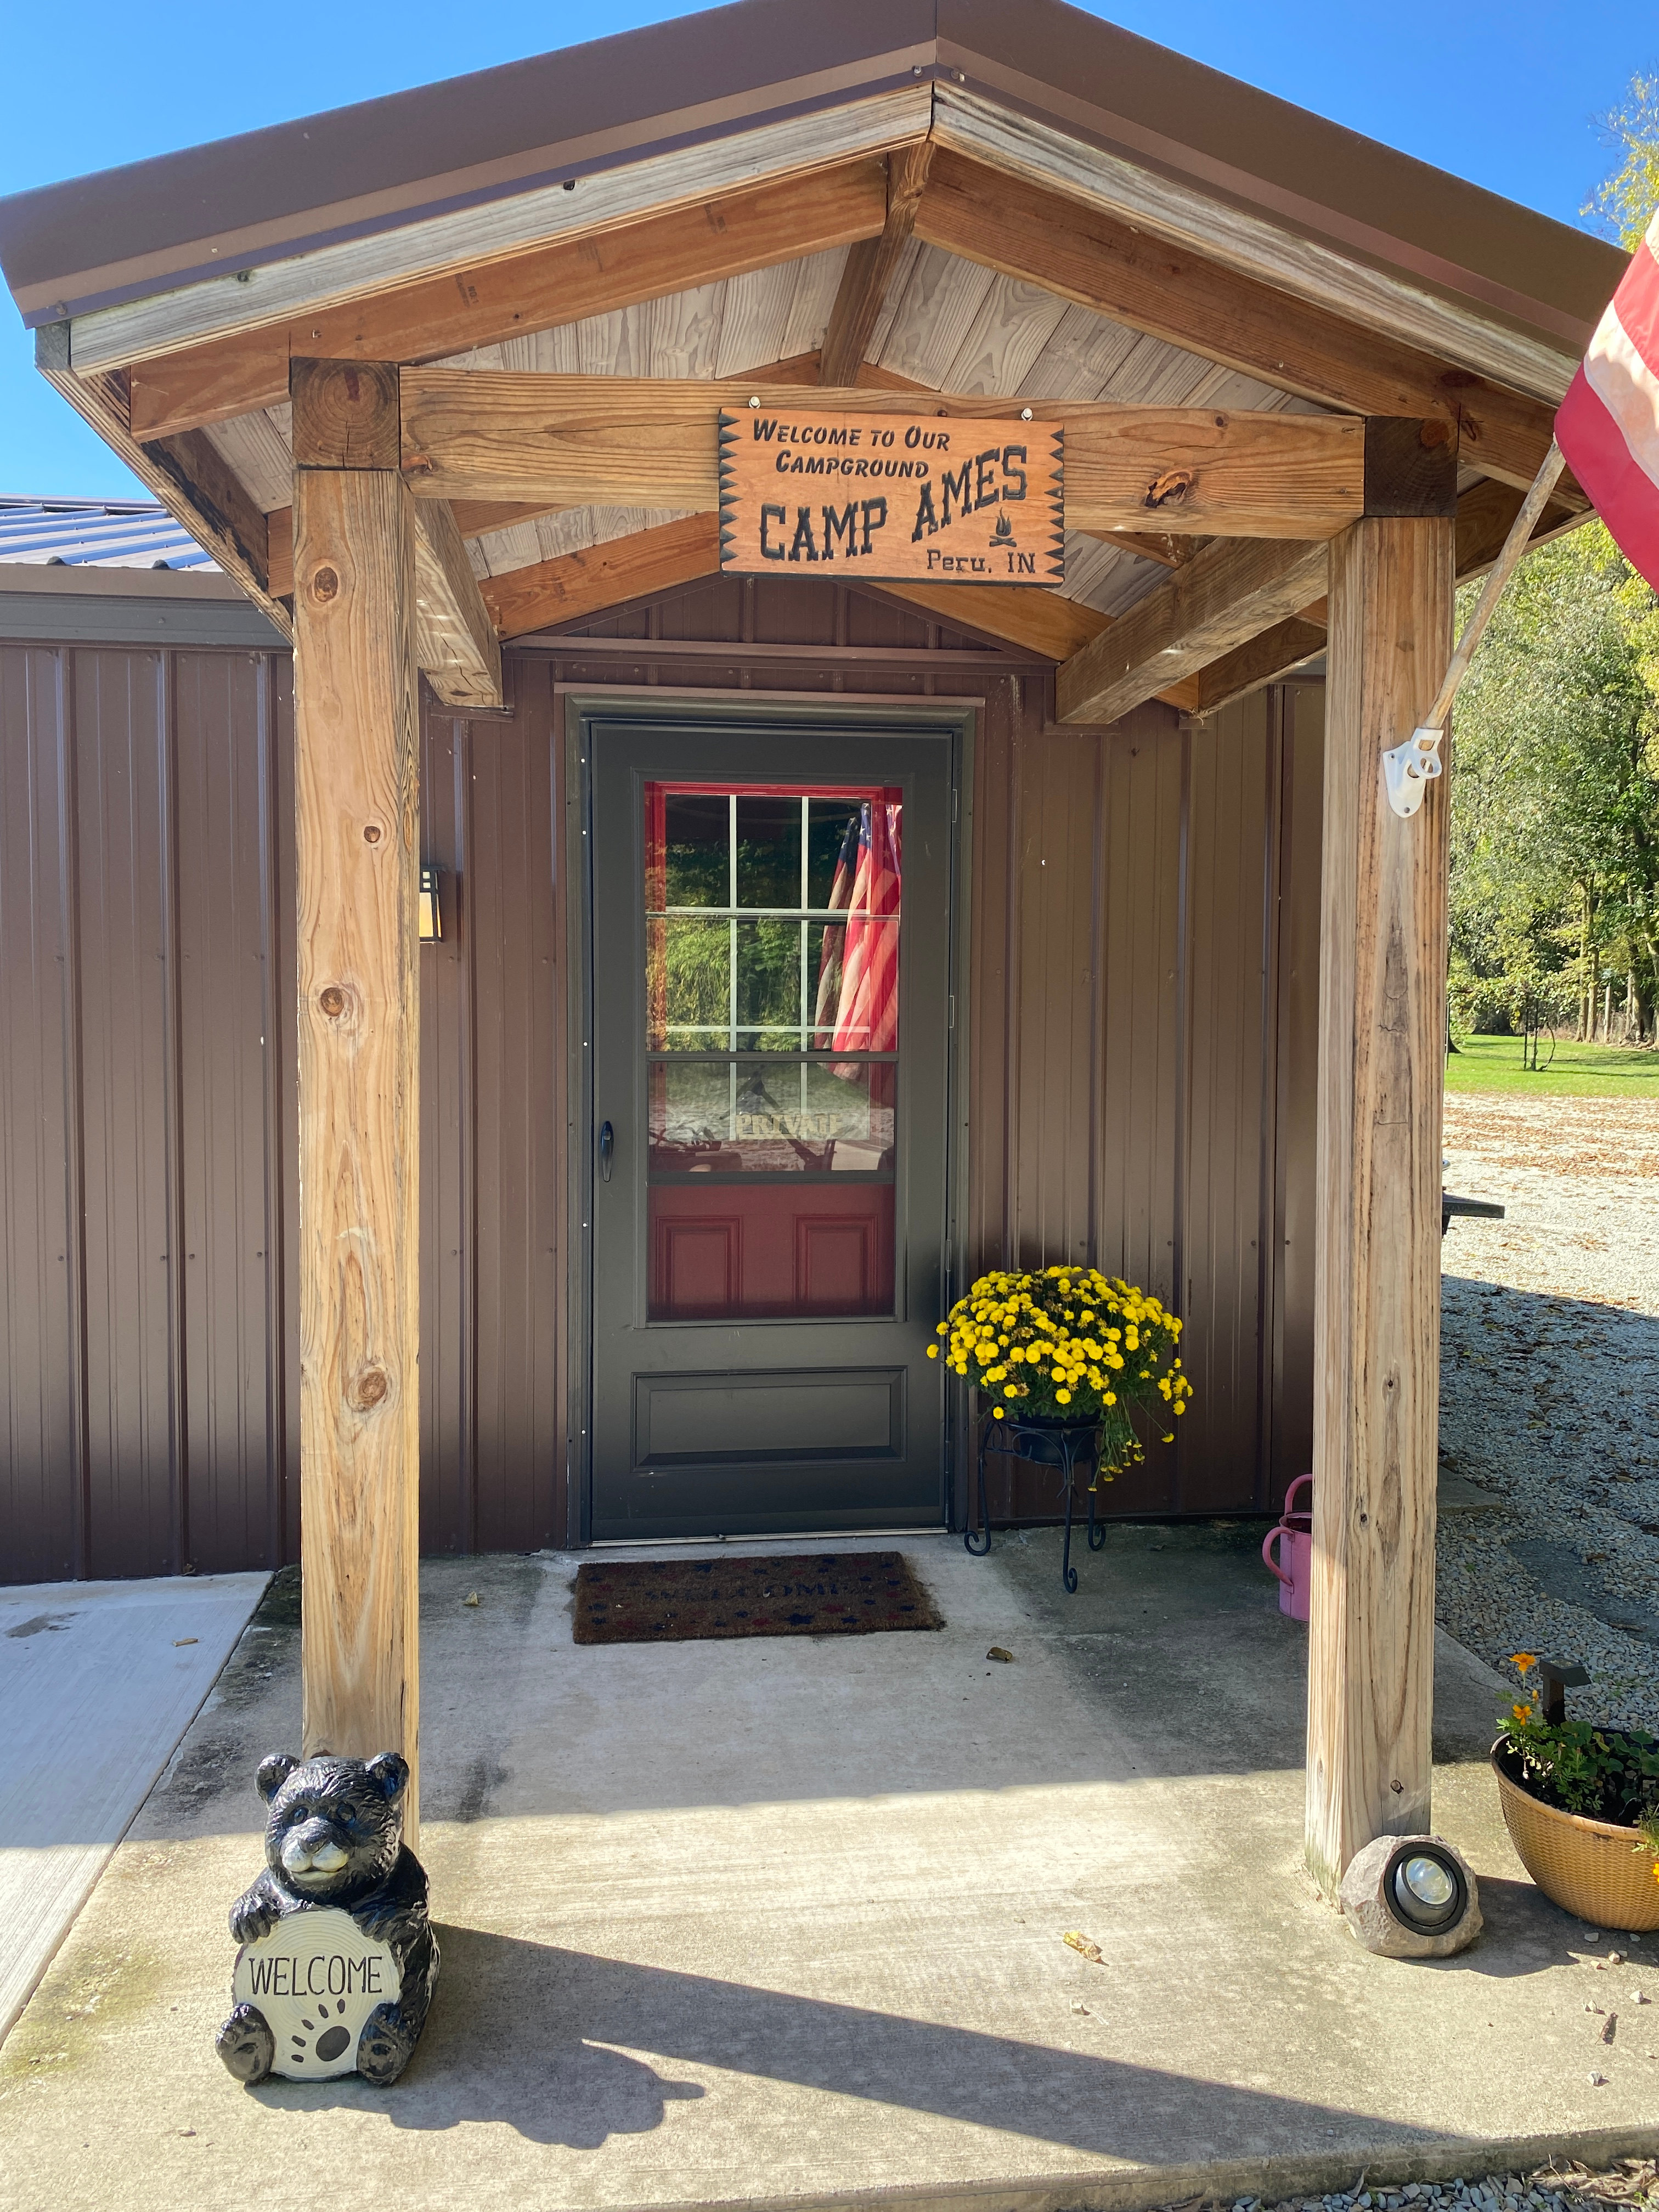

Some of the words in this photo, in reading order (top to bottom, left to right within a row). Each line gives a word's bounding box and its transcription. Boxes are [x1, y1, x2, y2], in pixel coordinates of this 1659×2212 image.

[753, 417, 862, 445] WELCOME
[871, 429, 895, 447] TO
[905, 425, 950, 451] OUR
[775, 449, 929, 478] CAMPGROUND
[759, 496, 888, 561] CAMP
[911, 444, 1028, 544] AMES
[926, 549, 992, 573] Peru,
[1007, 551, 1036, 574] IN
[736, 1113, 843, 1135] PRIVATE
[249, 1955, 382, 1995] WELCOME
